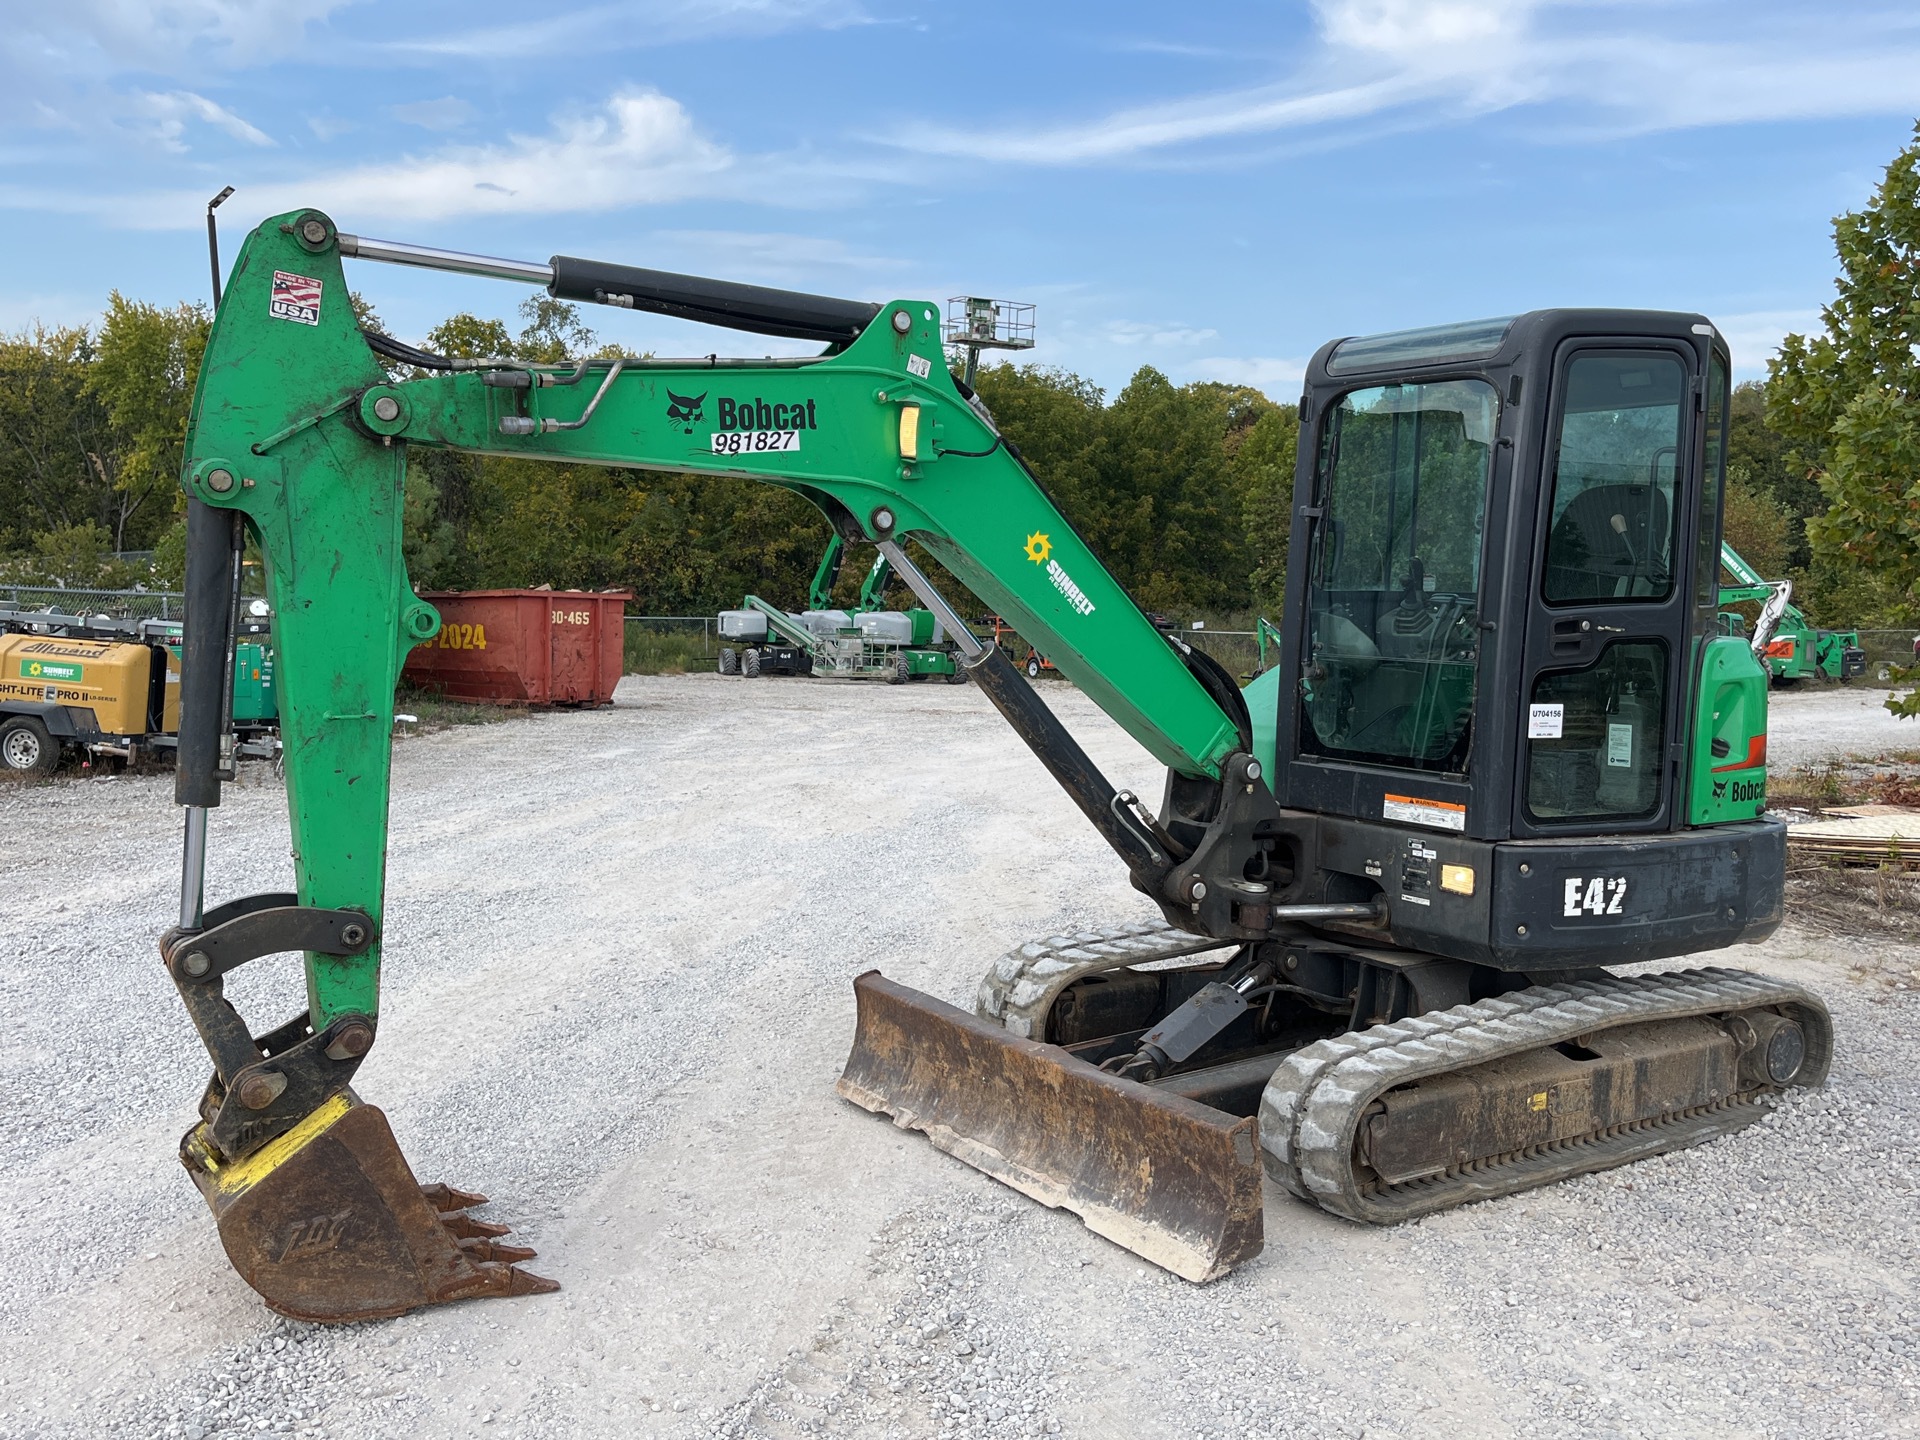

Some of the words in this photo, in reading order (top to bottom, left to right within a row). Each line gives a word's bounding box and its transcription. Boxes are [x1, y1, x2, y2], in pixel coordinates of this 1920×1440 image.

[273, 301, 315, 321] USA
[717, 397, 817, 431] Bobcat
[714, 431, 796, 453] 981827
[1045, 559, 1096, 616] SUNBELT
[1048, 575, 1082, 615] RENTALS
[20, 642, 111, 659] Allmand
[43, 665, 75, 677] SUNBELT
[57, 688, 80, 702] PRO
[82, 692, 89, 702] II
[1731, 779, 1766, 803] Bobca
[1415, 799, 1439, 808] WARNING
[1563, 876, 1627, 917] E42
